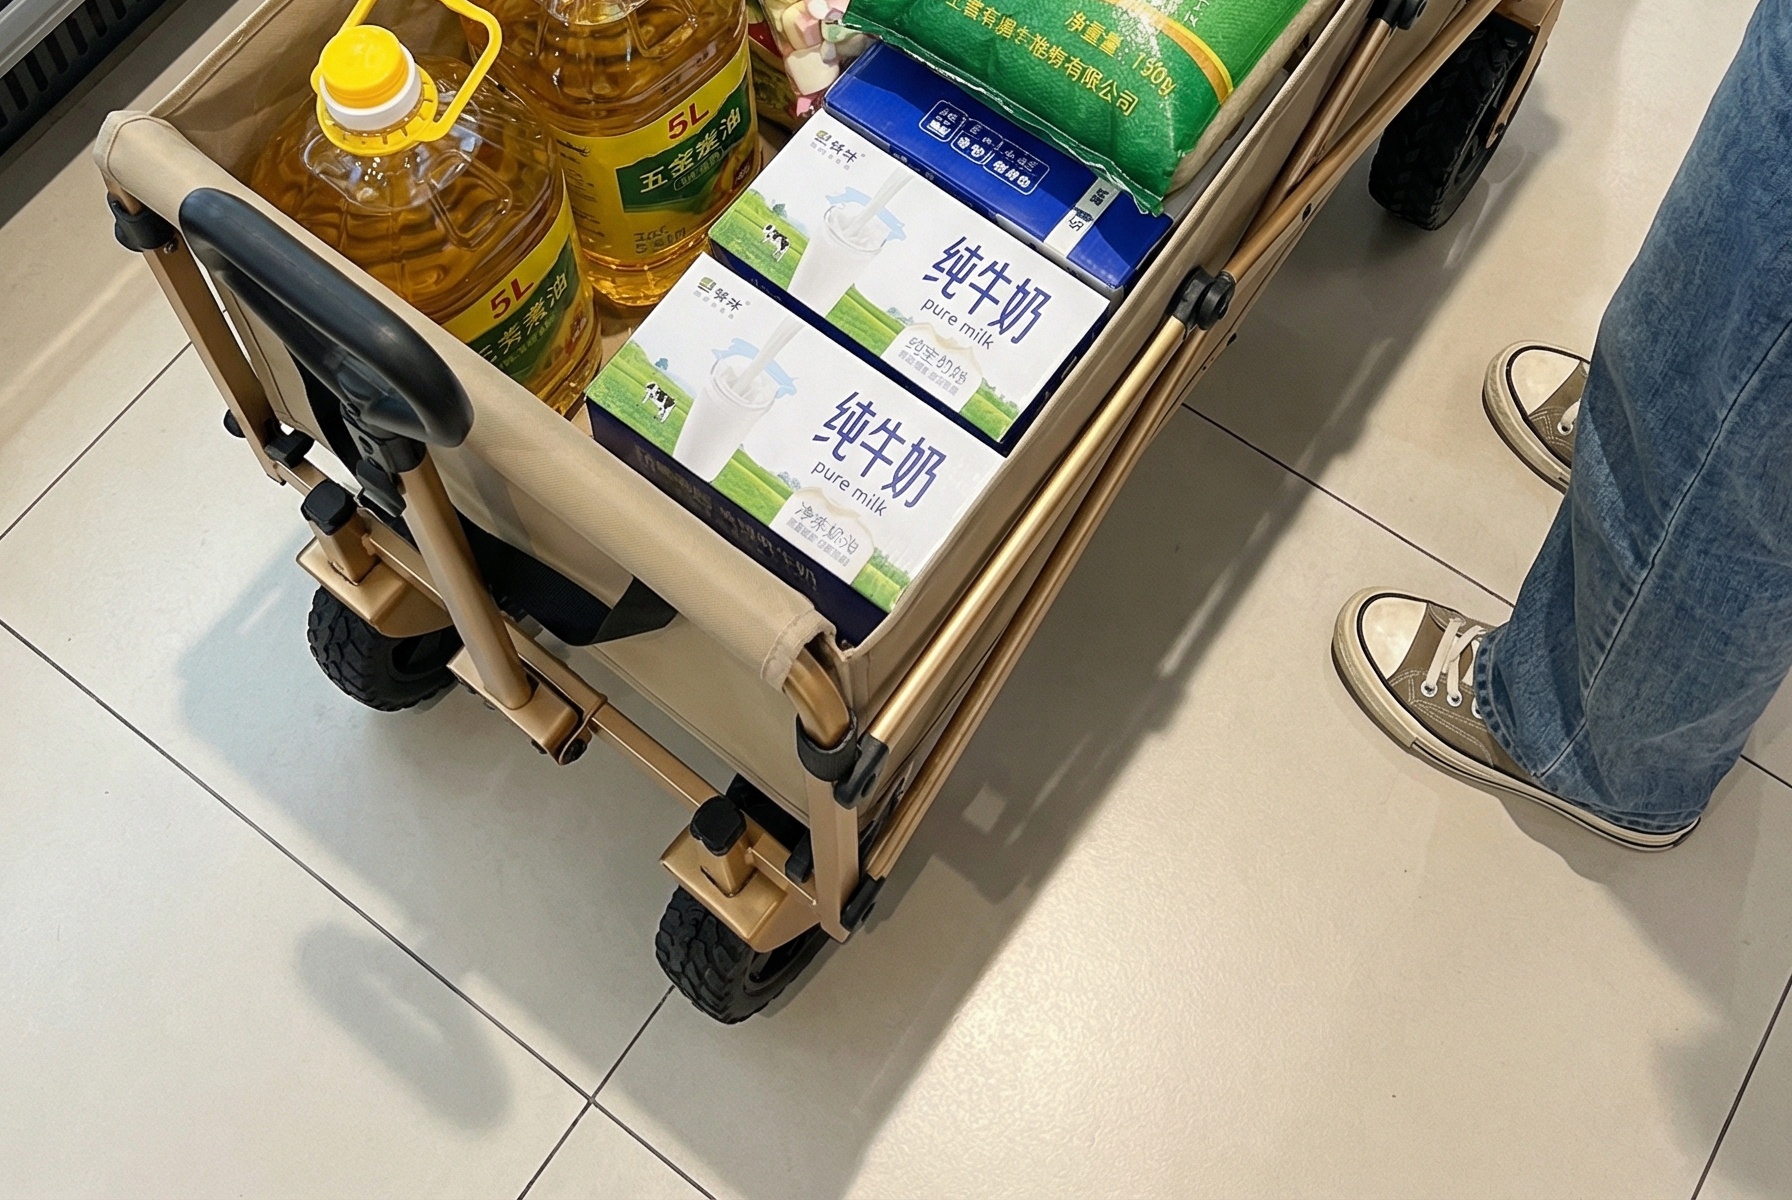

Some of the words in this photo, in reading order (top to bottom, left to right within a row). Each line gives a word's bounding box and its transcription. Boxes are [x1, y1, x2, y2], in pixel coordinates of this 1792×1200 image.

[668, 102, 710, 140] 5L
[490, 278, 535, 320] 5L
[922, 236, 1052, 344] 纯牛奶
[920, 298, 958, 326] pure
[958, 322, 994, 350] milk
[812, 391, 947, 508] 纯牛奶
[810, 461, 850, 492] pure
[851, 487, 888, 517] milk
